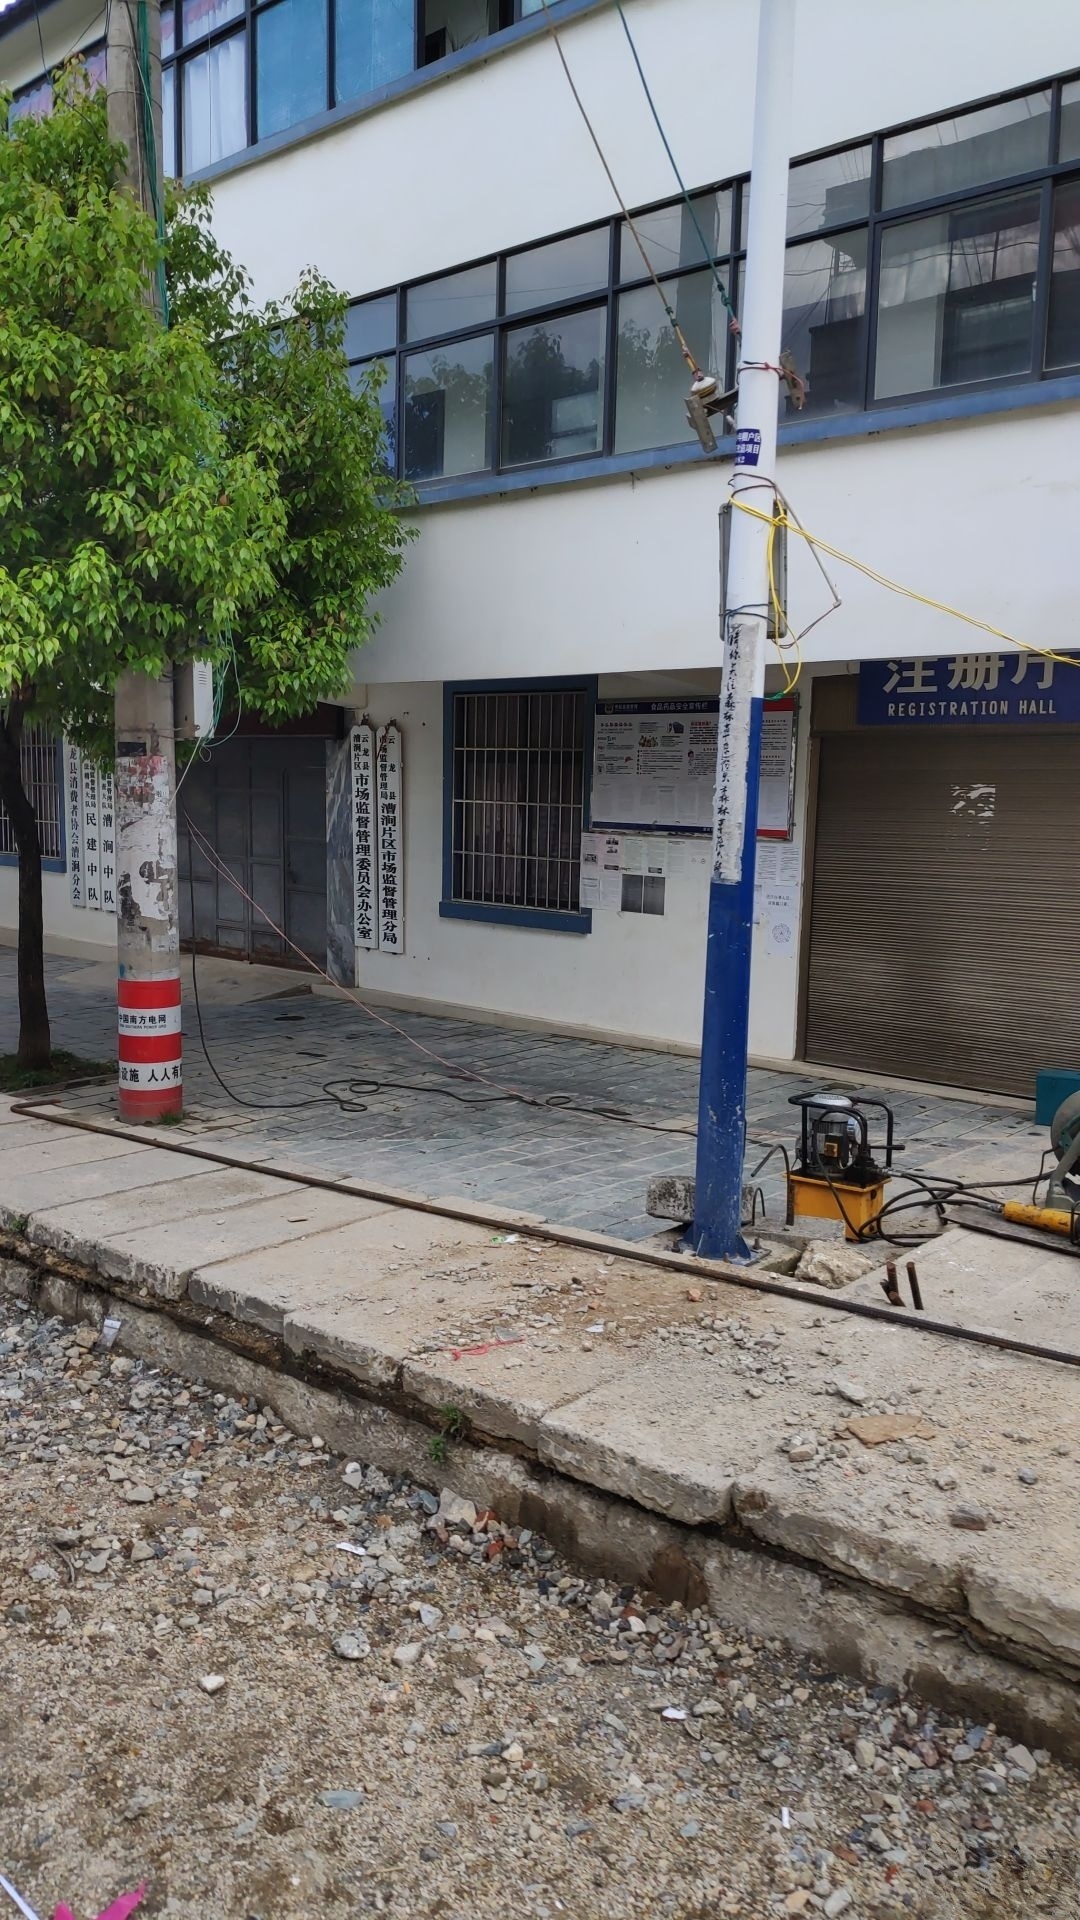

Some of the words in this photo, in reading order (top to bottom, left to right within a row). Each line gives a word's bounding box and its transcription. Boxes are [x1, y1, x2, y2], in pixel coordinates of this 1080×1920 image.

[888, 701, 1008, 716] REGISTRATION
[1019, 700, 1056, 714] HALL
[86, 813, 98, 900] 民建中队
[354, 773, 372, 940] 市场监督管理委员会办公室
[381, 803, 398, 945] 漕涧片区市场监督管理分局
[121, 1066, 140, 1083] 设施
